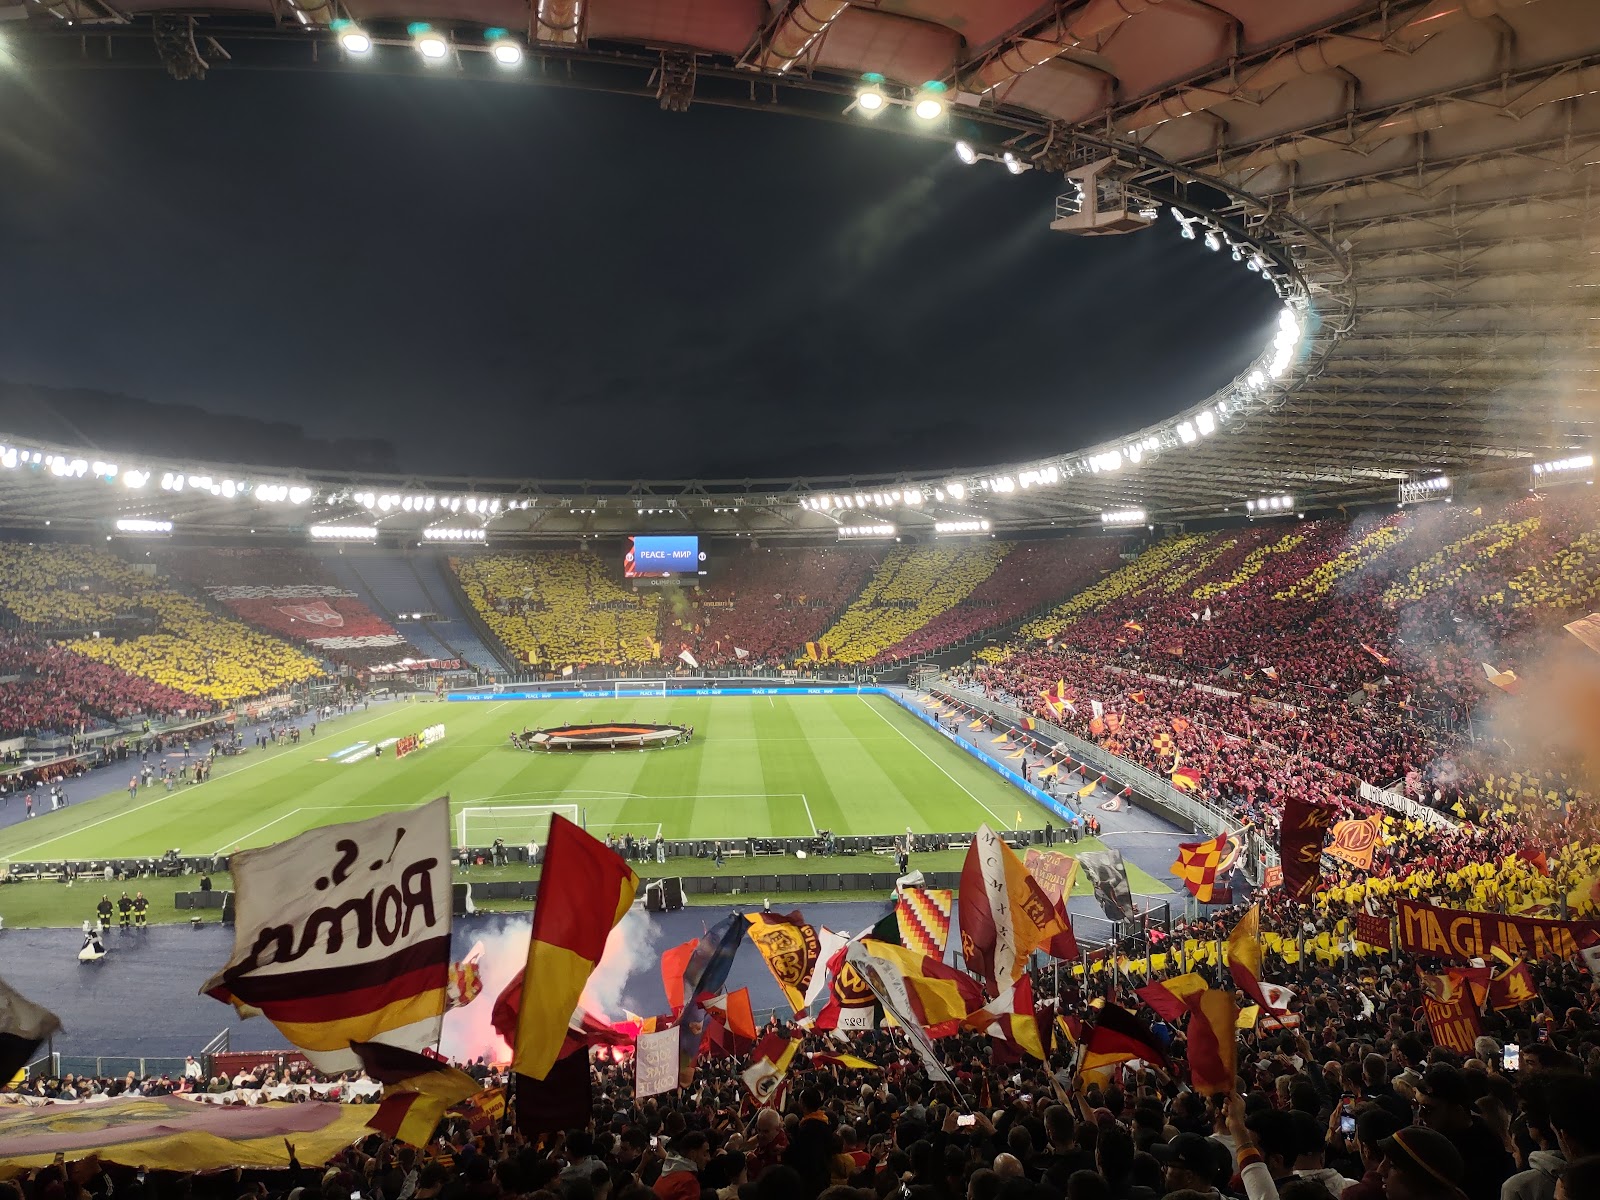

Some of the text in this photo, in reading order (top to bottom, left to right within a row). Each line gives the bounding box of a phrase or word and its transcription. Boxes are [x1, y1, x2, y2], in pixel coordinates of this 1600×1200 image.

[640, 551, 665, 559] PEACE
[672, 551, 692, 559] МИР
[1403, 904, 1580, 963] MAGLIANA
